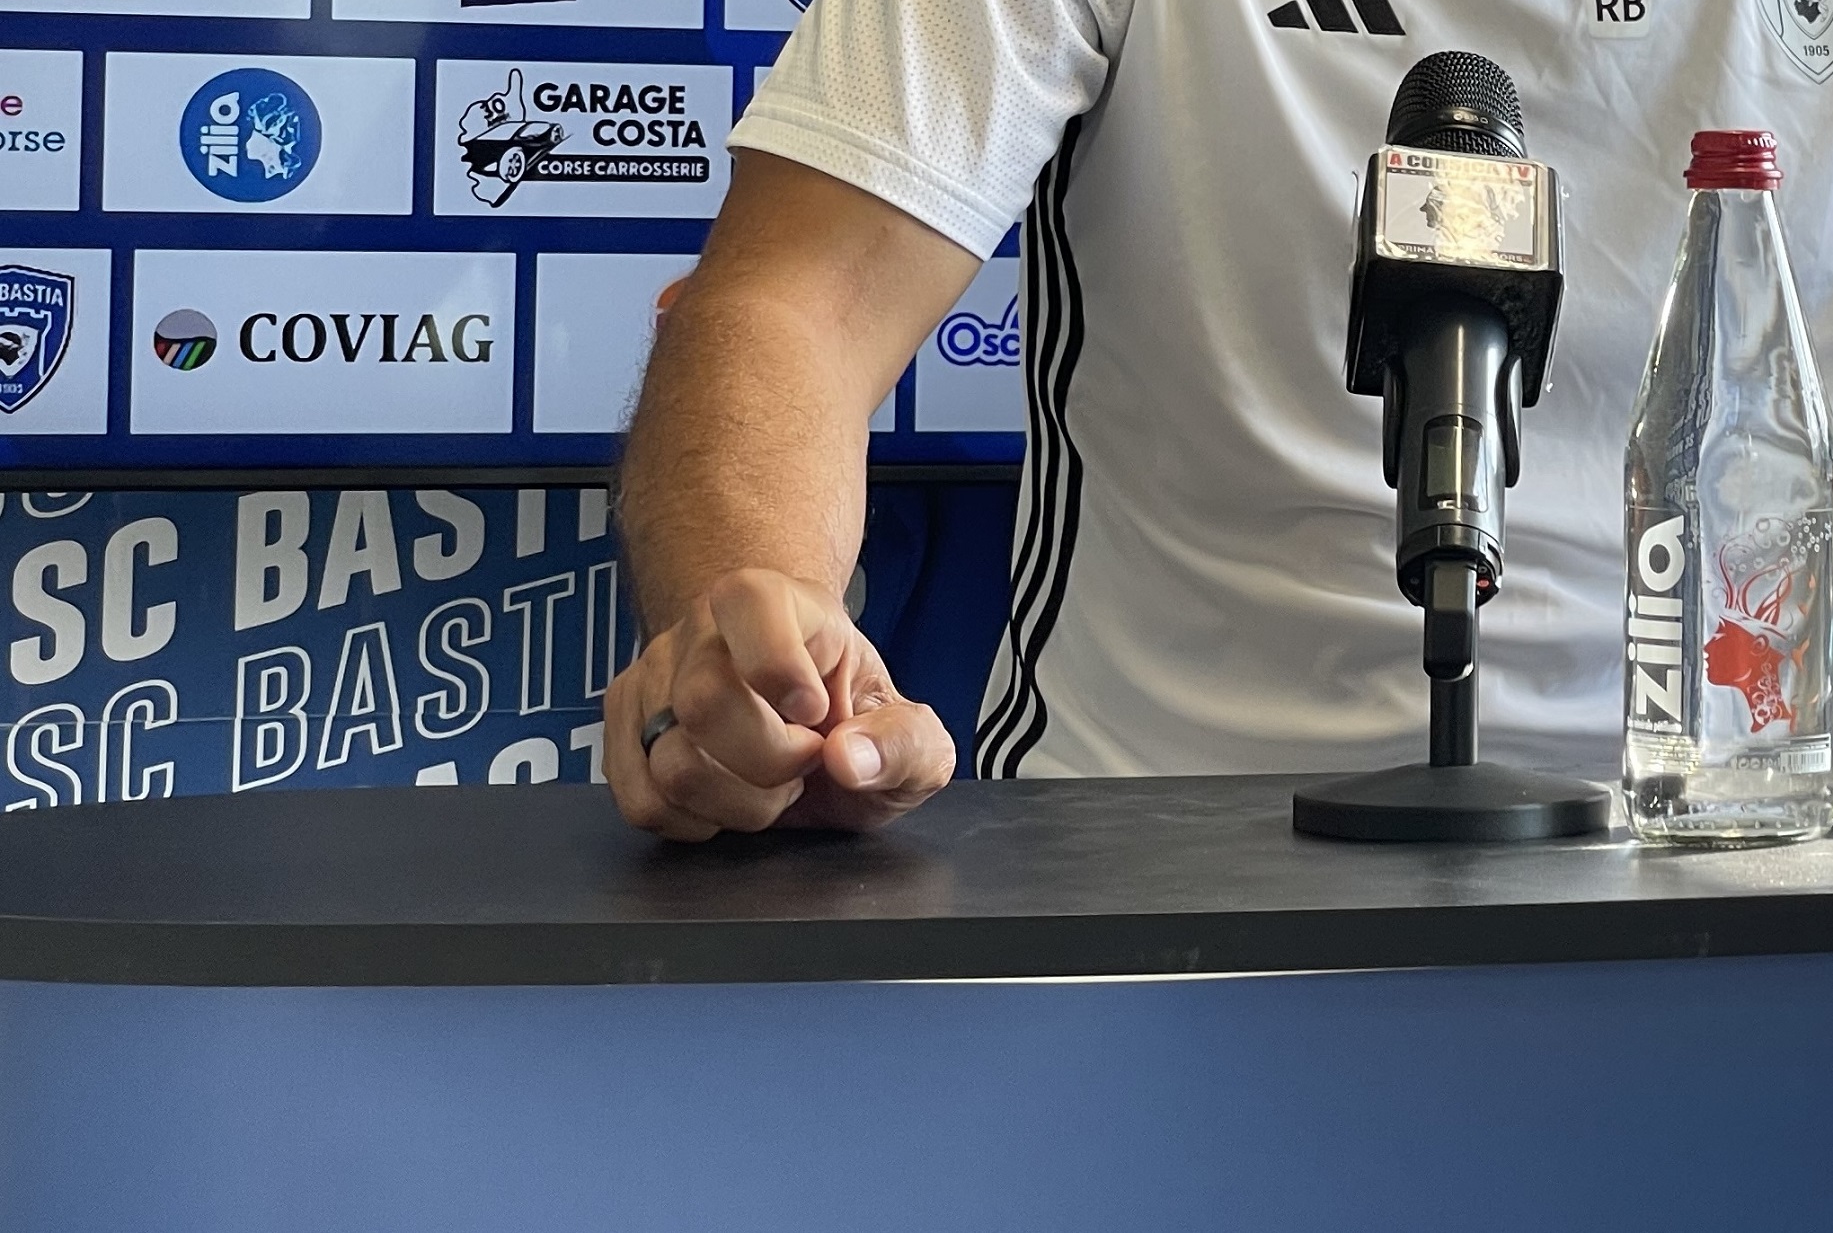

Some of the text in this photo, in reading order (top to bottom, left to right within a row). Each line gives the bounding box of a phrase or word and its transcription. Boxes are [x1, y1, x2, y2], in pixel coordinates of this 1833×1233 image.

[1803, 45, 1830, 57] 1905
[533, 82, 686, 114] GARAGE
[208, 92, 241, 178] zilia
[592, 119, 706, 148] COSTA
[537, 160, 705, 178] CORSE CARROSSERIE
[0, 282, 64, 307] BASTIA
[238, 312, 494, 366] COVIAG
[947, 321, 1020, 357] Osc
[10, 489, 607, 686] SC BAS
[1628, 514, 1685, 723] zilia
[5, 560, 640, 813] SC BASTI
